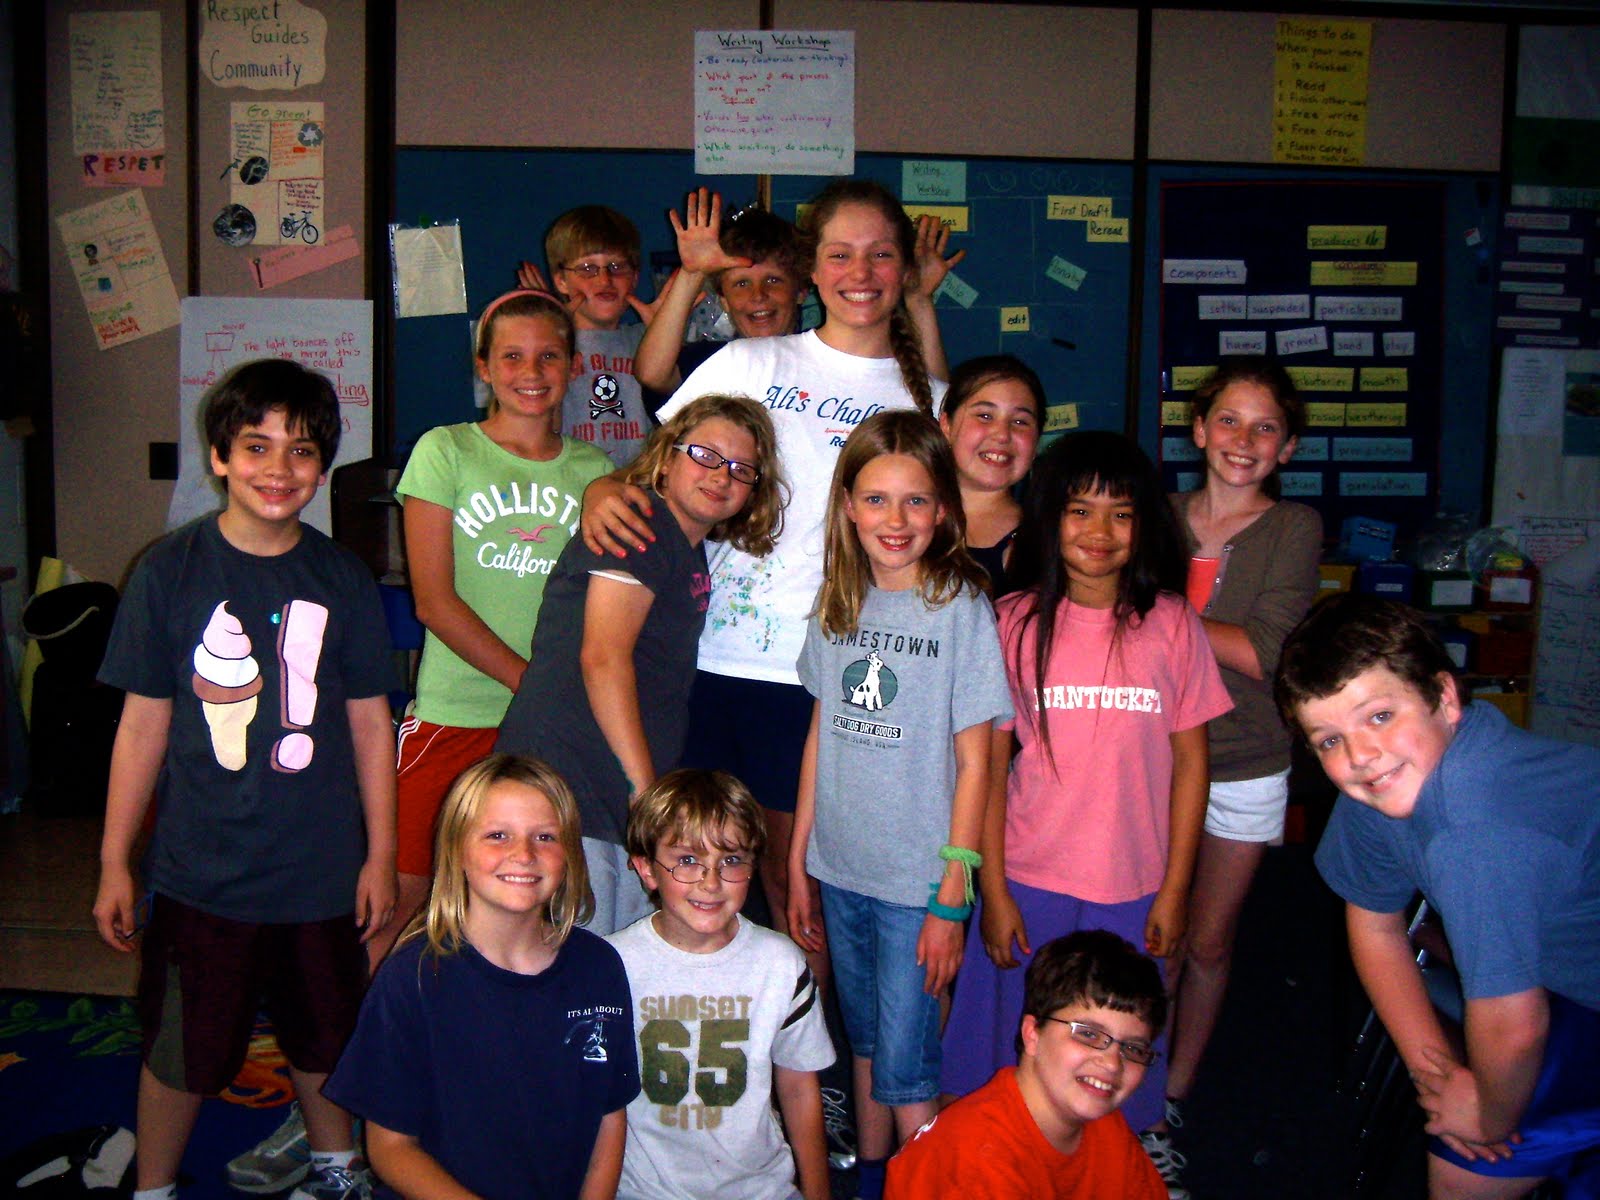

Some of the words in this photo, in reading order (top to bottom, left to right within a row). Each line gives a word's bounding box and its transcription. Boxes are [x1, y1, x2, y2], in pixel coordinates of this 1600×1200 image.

[207, 0, 282, 27] Respect
[252, 23, 310, 45] Guides
[1279, 21, 1318, 41] Things
[1324, 26, 1336, 39] to
[1340, 29, 1355, 40] do
[718, 33, 763, 54] Writing
[210, 50, 302, 86] Community
[1295, 79, 1327, 93] Read
[83, 154, 165, 178] RESPET
[1052, 202, 1077, 216] First
[1080, 203, 1109, 218] Draft
[1007, 310, 1027, 325] edit
[266, 336, 287, 352] light
[335, 331, 355, 347] off
[1284, 333, 1319, 353] gravel
[313, 357, 345, 369] called
[336, 373, 370, 407] ting
[817, 397, 885, 426] Chall
[455, 482, 580, 539] HOLLIST
[477, 541, 557, 578] Californ
[860, 722, 875, 734] DRY
[875, 725, 899, 738] GOODS
[583, 1008, 592, 1016] AL
[594, 1005, 623, 1016] ABOUT
[639, 1019, 750, 1107] 65
